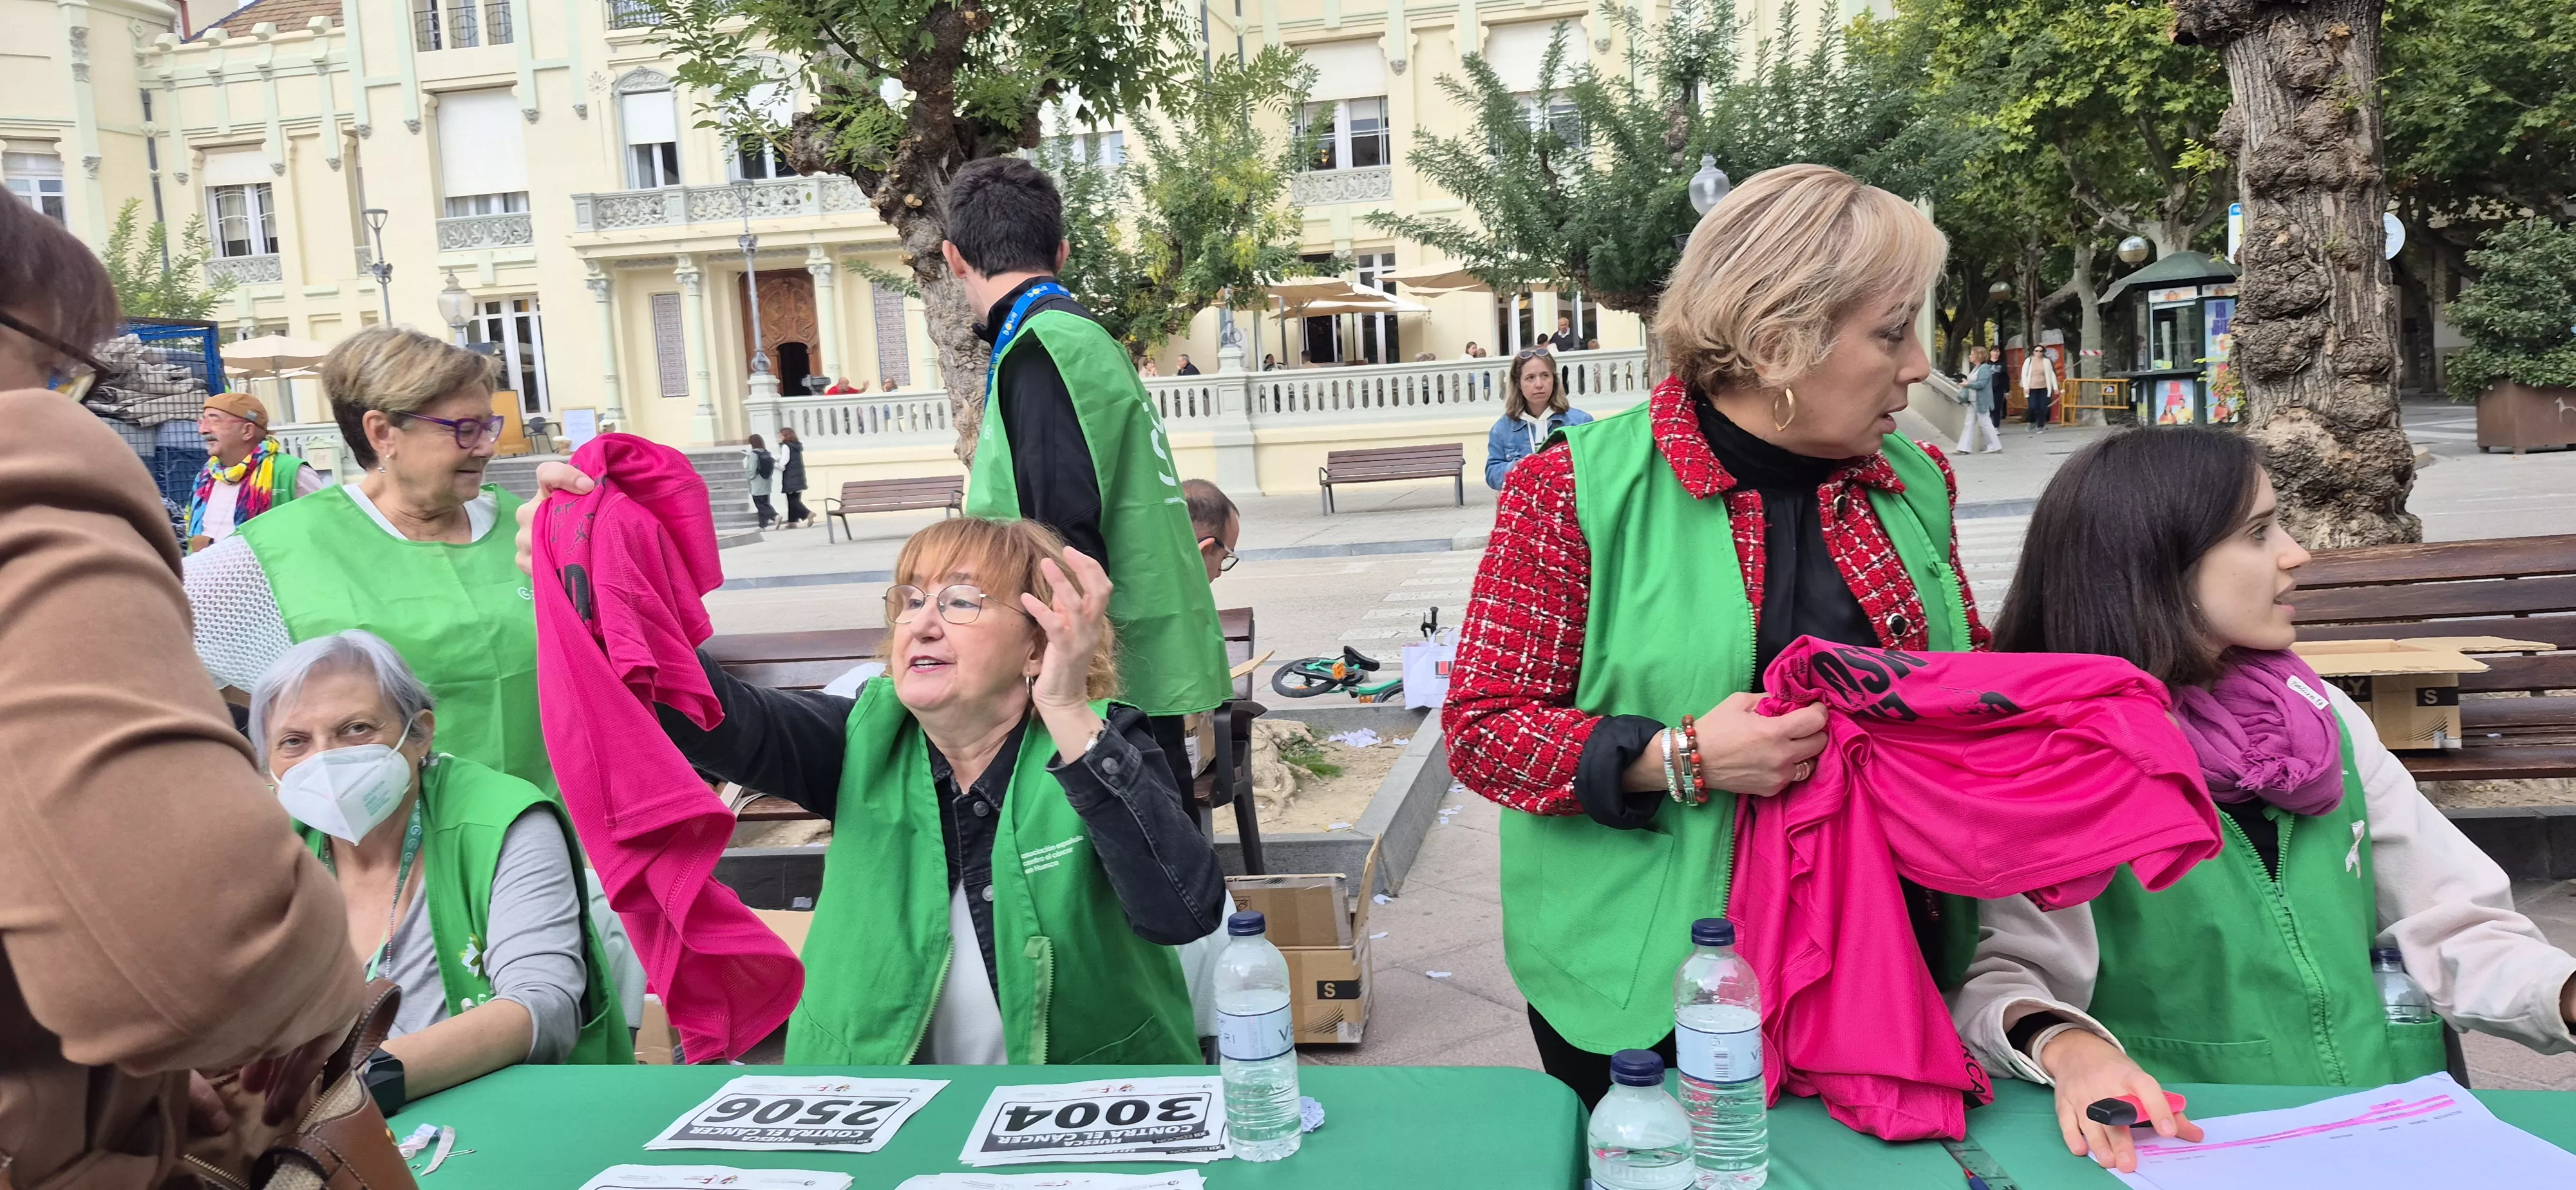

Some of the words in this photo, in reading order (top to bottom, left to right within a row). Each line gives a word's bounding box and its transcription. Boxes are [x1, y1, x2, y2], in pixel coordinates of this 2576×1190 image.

[2424, 689, 2438, 704] S
[1323, 983, 1336, 997] S
[704, 1097, 899, 1126] 2506
[1005, 1096, 1203, 1132] 3004
[688, 1126, 761, 1138] CÁNCER
[762, 1128, 782, 1137] EL
[786, 1128, 865, 1139] CONTRA
[1084, 1131, 1104, 1140] EL
[1109, 1125, 1194, 1138] CONTRA
[742, 1135, 793, 1143] HUESCA
[997, 1134, 1074, 1146] CÁNCER
[1064, 1137, 1122, 1146] HUESCA
